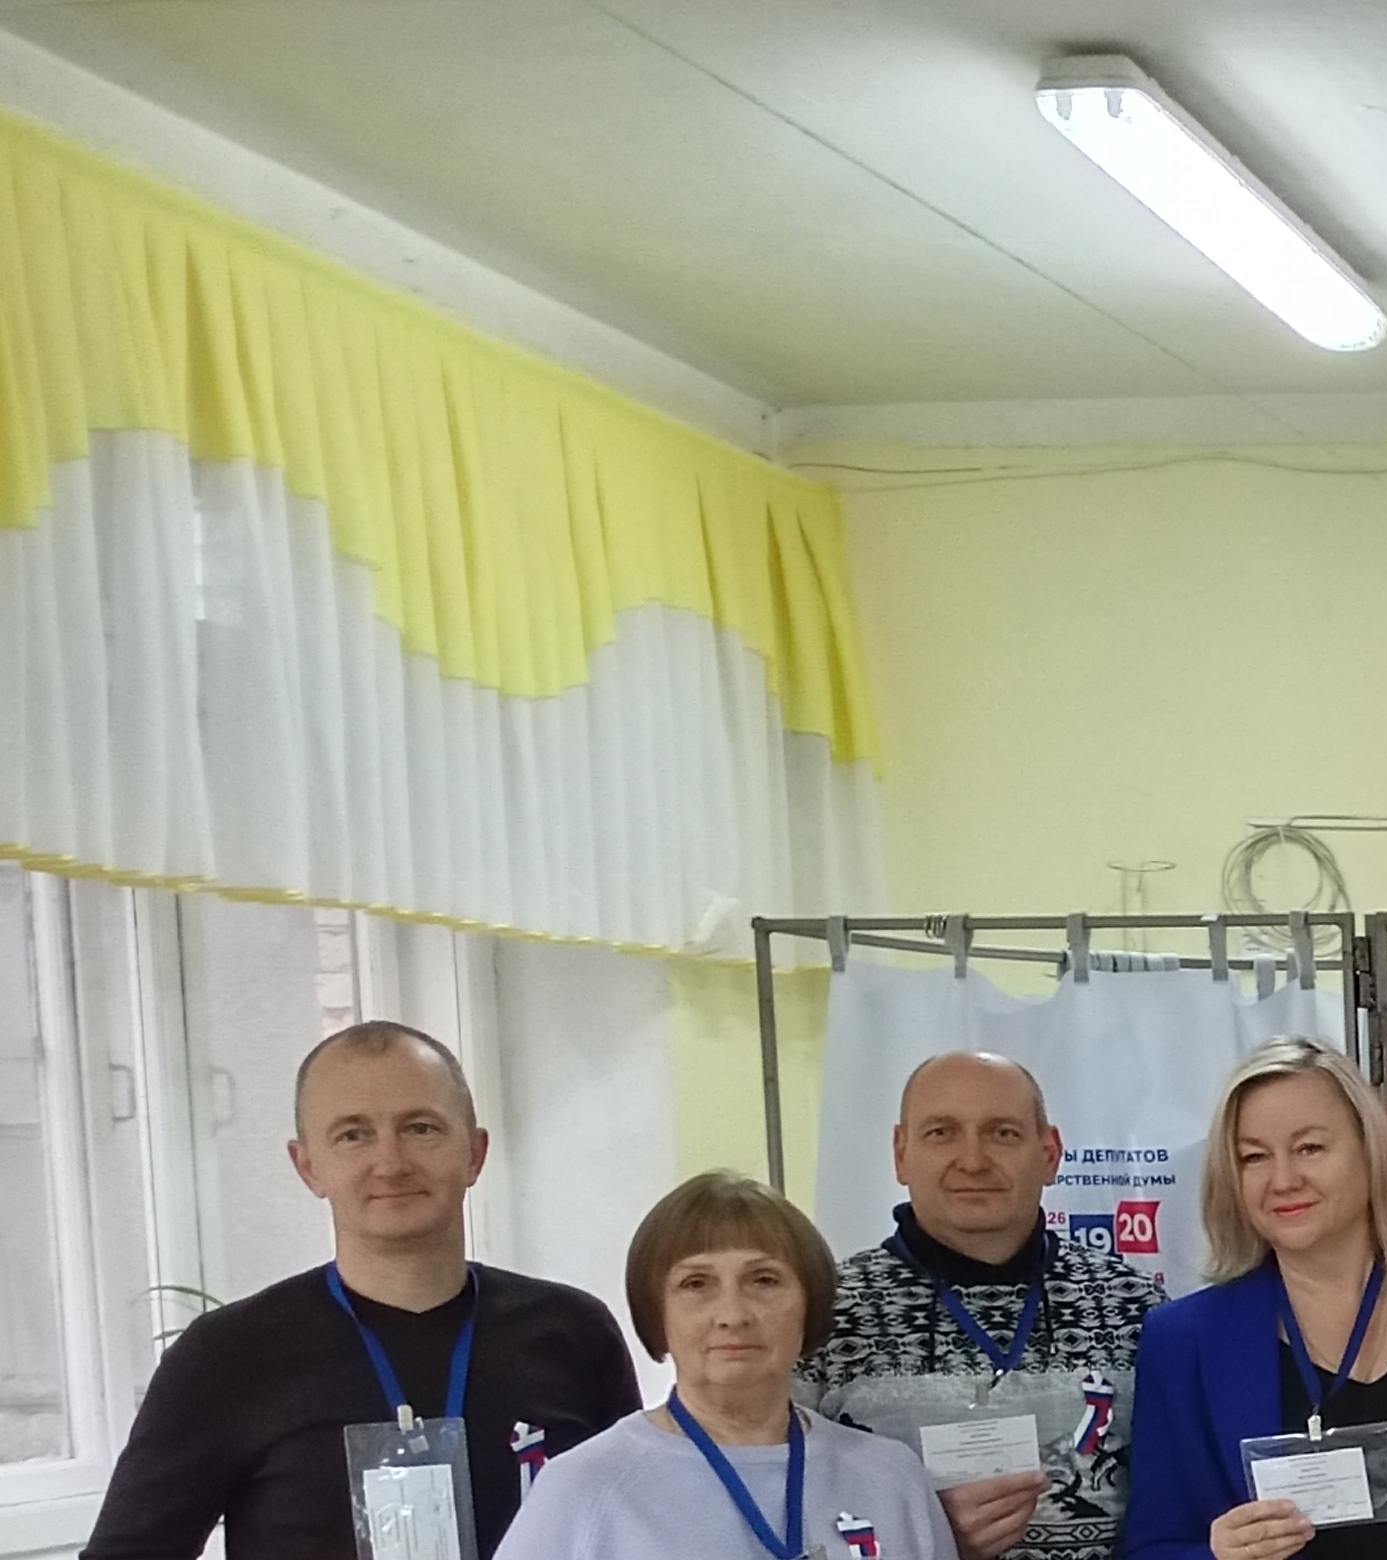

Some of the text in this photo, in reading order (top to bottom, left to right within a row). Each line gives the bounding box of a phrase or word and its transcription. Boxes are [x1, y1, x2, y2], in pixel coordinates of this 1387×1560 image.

[1055, 1173, 1177, 1187] РСТВЕННОЙ ДУМЫ
[1047, 1211, 1067, 1225] 26
[1073, 1212, 1153, 1255] 19 20
